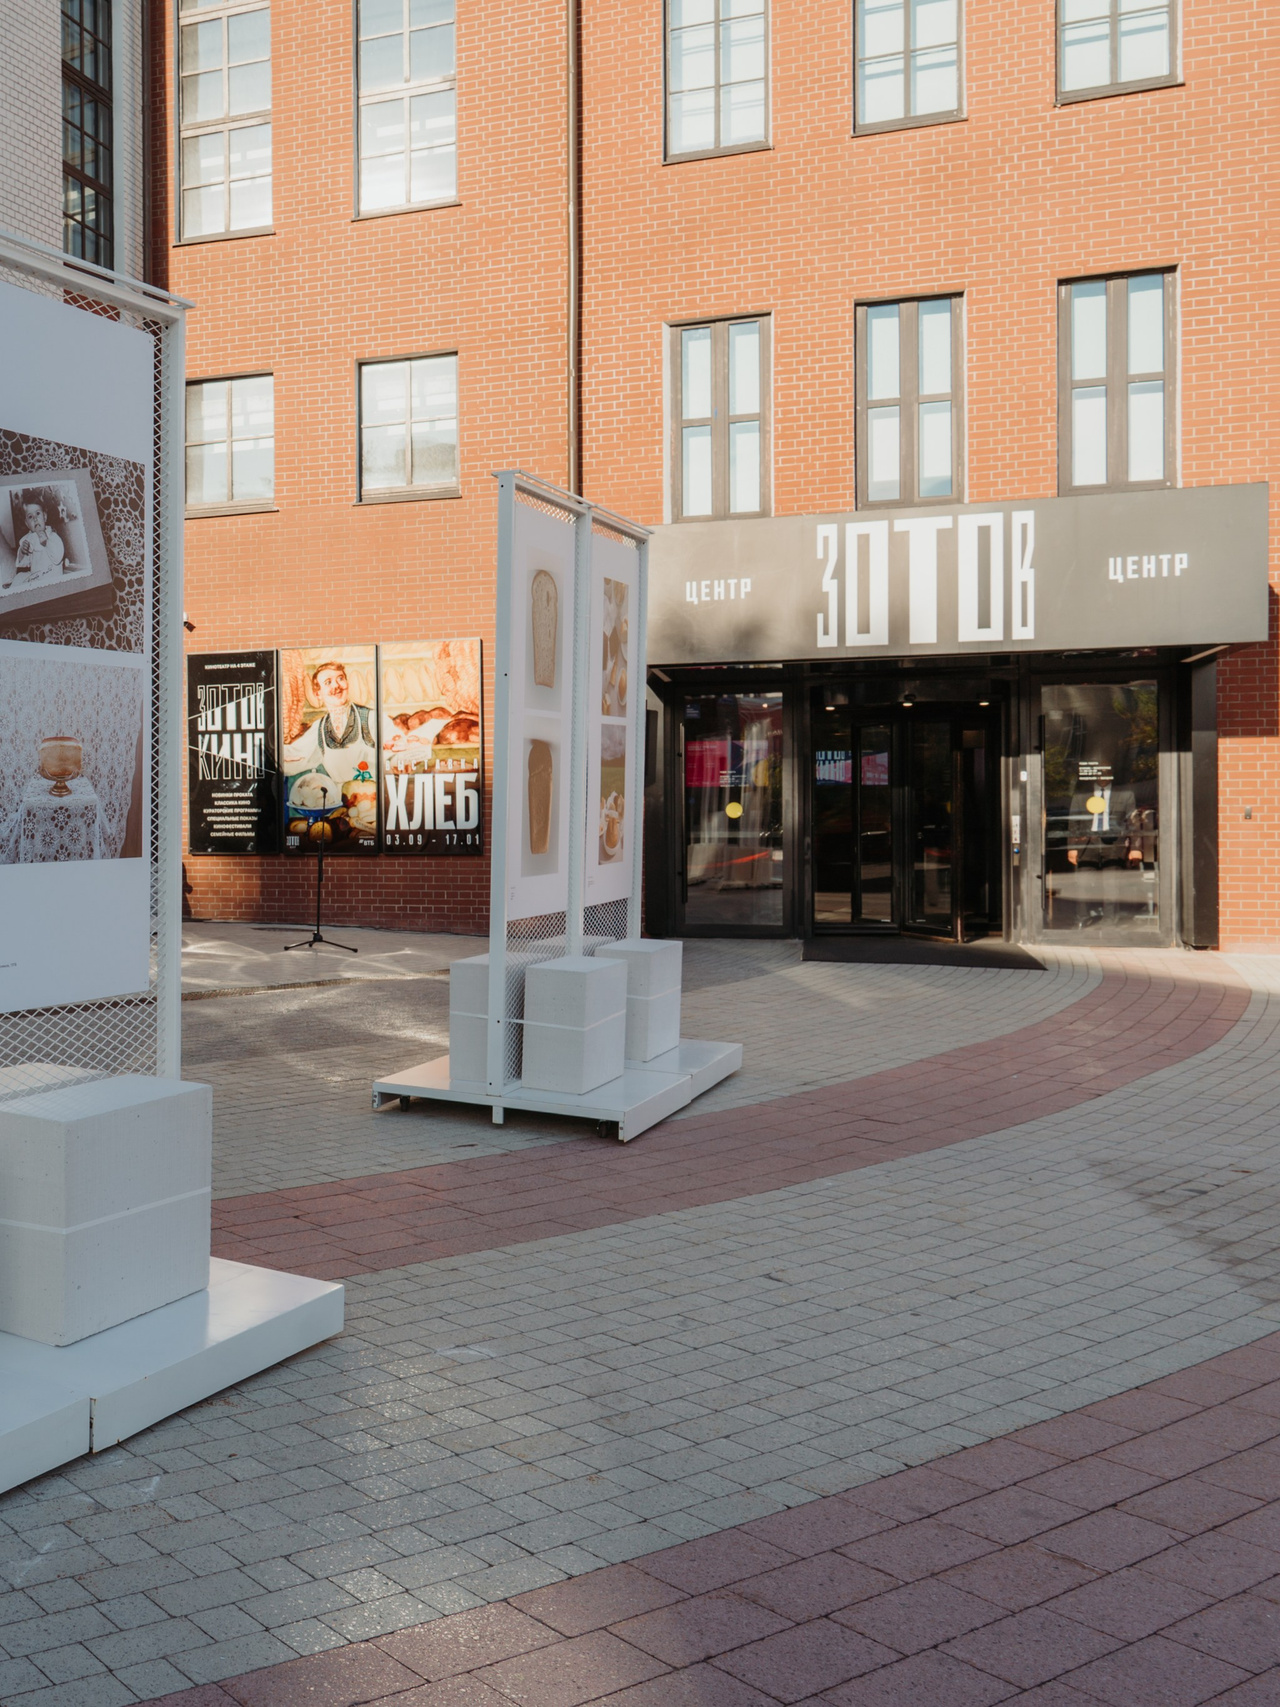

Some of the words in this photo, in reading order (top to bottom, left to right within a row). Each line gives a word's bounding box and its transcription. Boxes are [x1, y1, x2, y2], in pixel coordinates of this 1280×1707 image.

[685, 578, 751, 605] ЦЕНТР
[817, 510, 1035, 648] ЗОТОВ
[1108, 553, 1188, 583] ЦЕНТР
[197, 682, 265, 731] ЗОТОВ
[198, 732, 265, 780] КИНО
[385, 758, 479, 771] ВЫСТАВКА
[385, 772, 479, 830] ХЛЕБ
[386, 833, 423, 845] 03.09
[445, 834, 479, 845] 17.01
